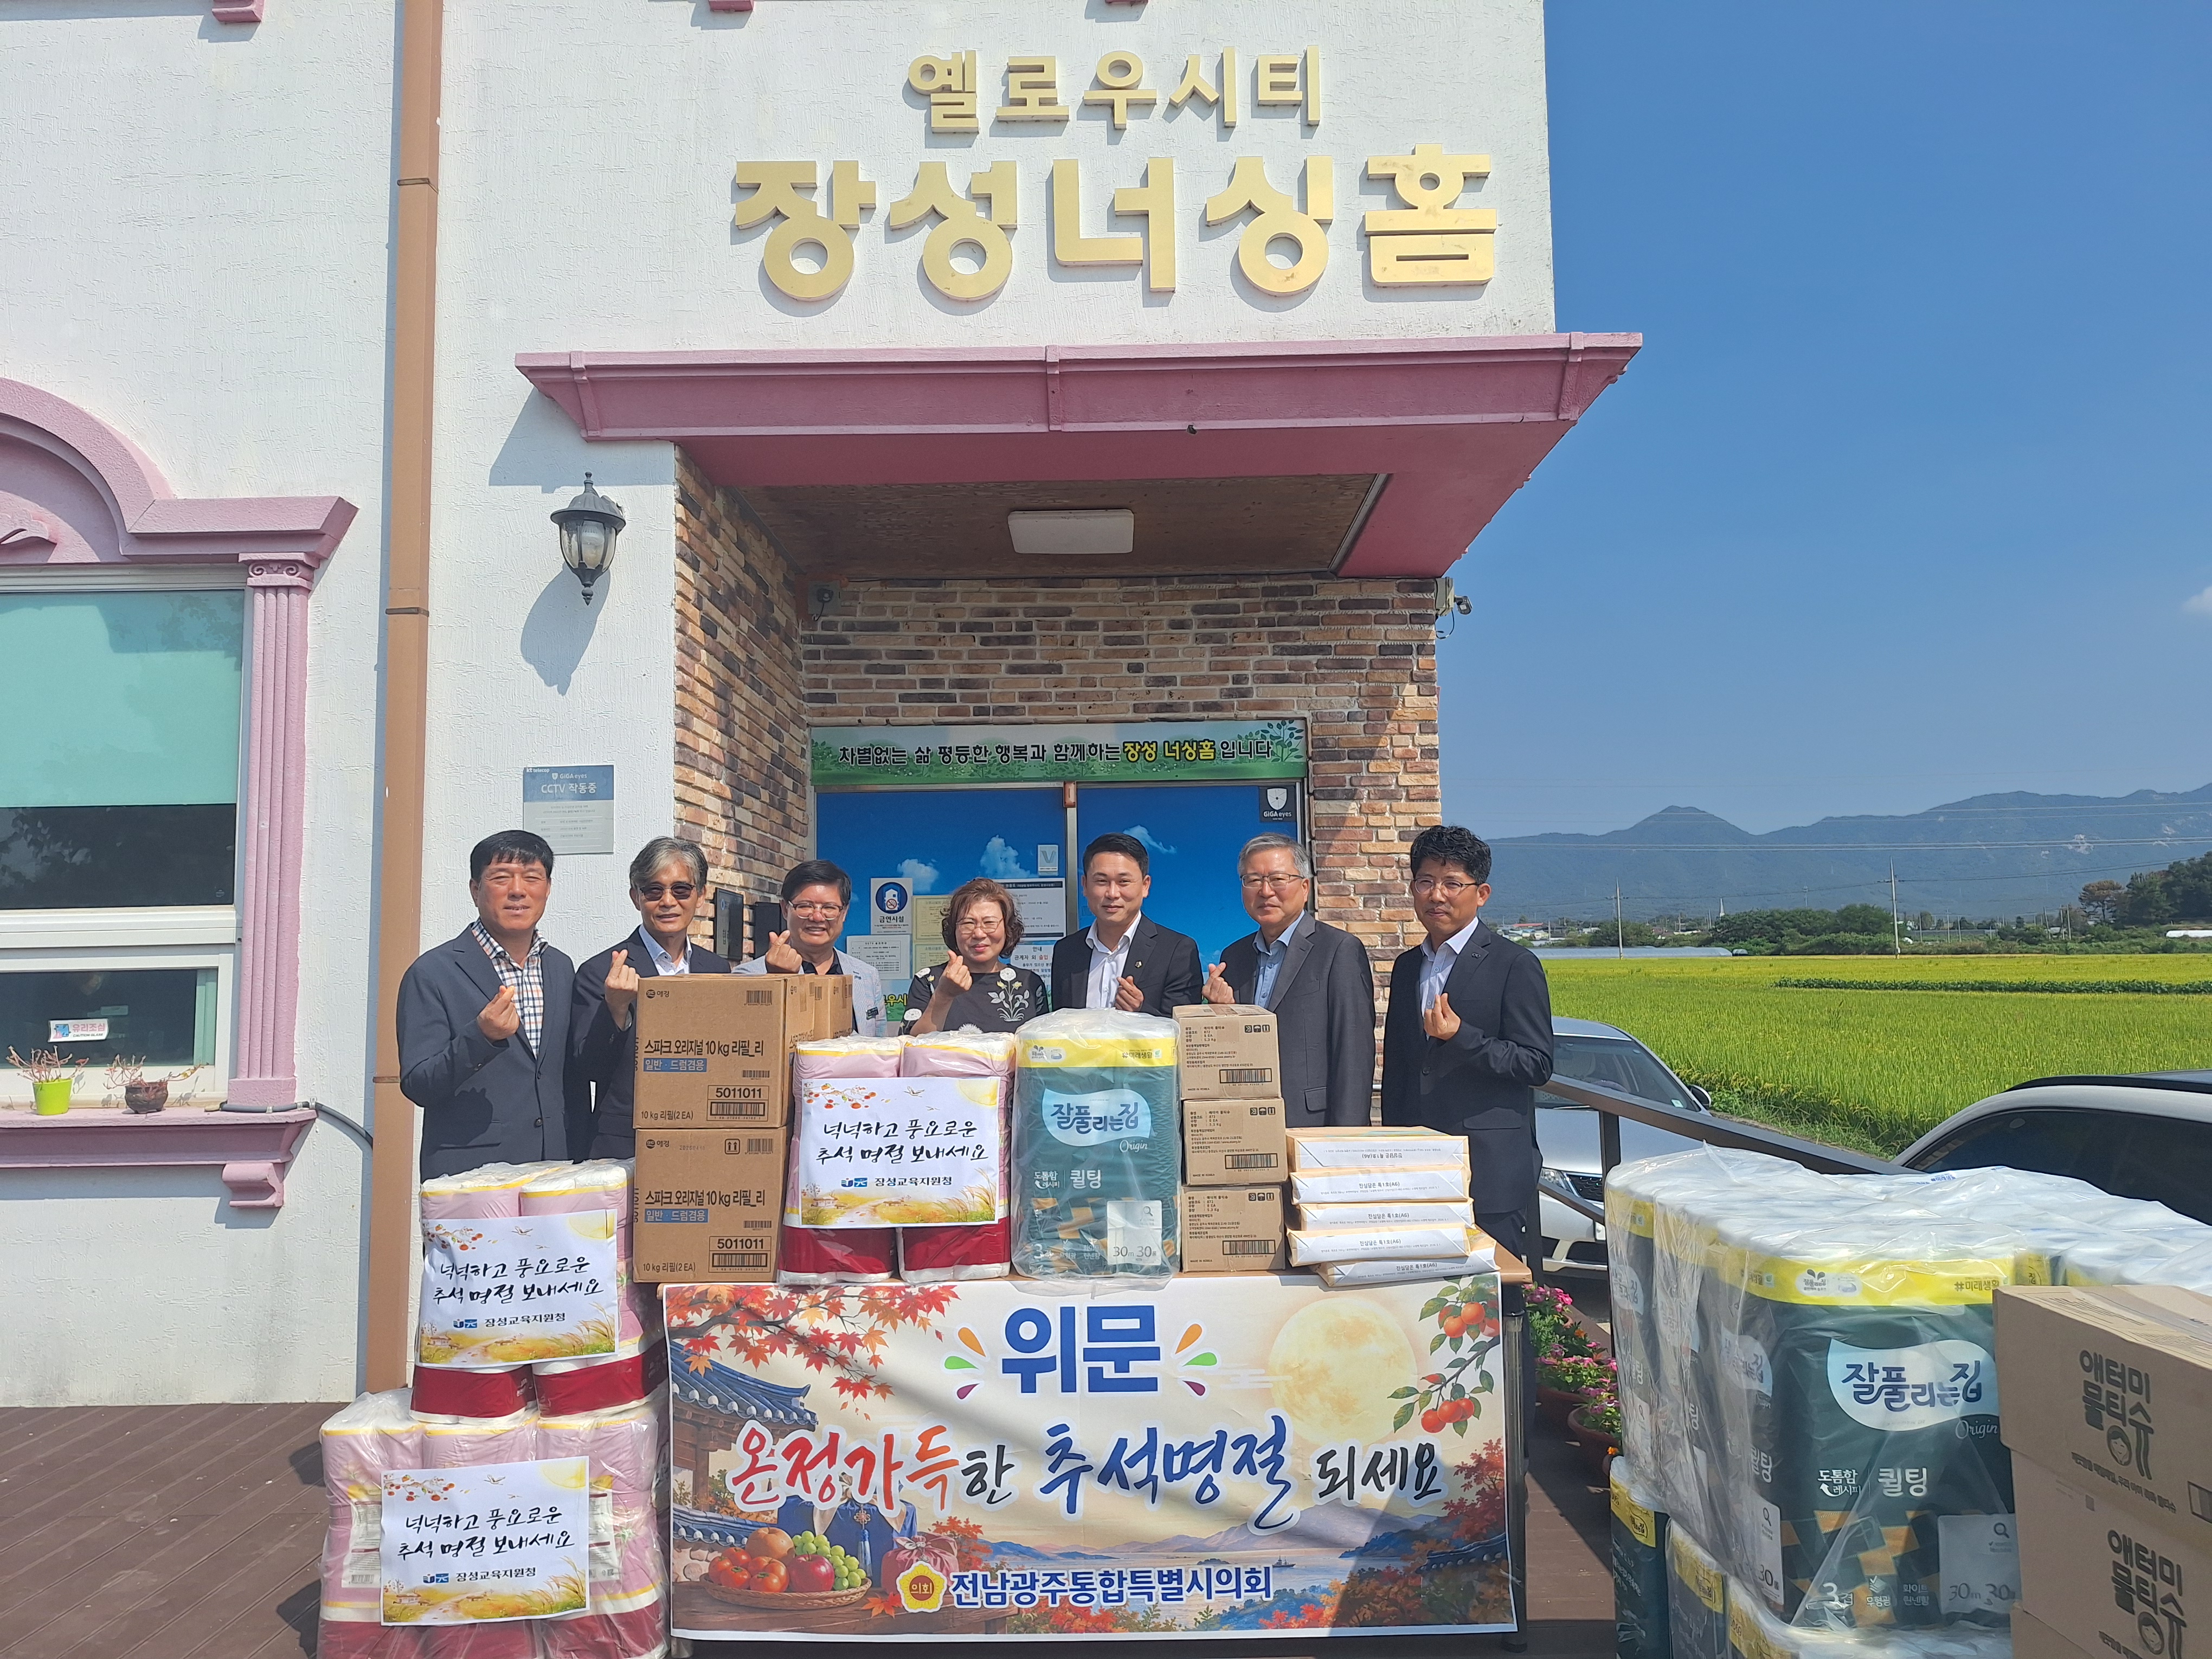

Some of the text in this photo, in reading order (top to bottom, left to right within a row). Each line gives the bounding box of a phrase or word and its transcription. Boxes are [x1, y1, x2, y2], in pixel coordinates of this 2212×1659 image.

[908, 45, 1321, 133] 옐로우시티
[735, 142, 1497, 301] 장성너싱홈
[839, 745, 908, 766] 차별없는
[915, 745, 931, 764] 삶
[938, 744, 989, 764] 평등한
[995, 743, 1047, 764] 행복과
[1123, 741, 1158, 762] 장성
[1162, 739, 1216, 761] 너싱홈
[1219, 739, 1274, 759] 입니다
[541, 782, 597, 794] CCTV 작동중
[657, 989, 670, 998] 애경
[72, 1023, 105, 1033] 유리조심
[644, 1039, 673, 1054] 스파크
[674, 1039, 703, 1056] 오리지널
[706, 1040, 716, 1054] 10
[717, 1040, 730, 1056] kg
[645, 1059, 705, 1071] 일반 드럼겸용
[716, 1088, 761, 1098] 5011011
[650, 1111, 658, 1121] kg
[660, 1110, 680, 1121] 리필(2
[681, 1109, 693, 1120] EA)
[1051, 1102, 1139, 1134] 잘풀리는집
[824, 1119, 978, 1140] 넉넉하고 풍요로운
[815, 1144, 989, 1165] 추석 명절 보내세요
[1119, 1139, 1148, 1153] Origin
[874, 1176, 953, 1186] 장성교육지원청
[1033, 1170, 1058, 1181] 도톰함
[1042, 1180, 1060, 1188] 레시피
[1070, 1169, 1102, 1189] 퀼팅
[645, 1189, 673, 1205] 스파크
[674, 1189, 704, 1206] 오리지널
[706, 1192, 717, 1205] 10
[719, 1192, 731, 1206] kg
[646, 1210, 705, 1221] 일반 드럼겸용
[717, 1238, 763, 1249] 5011011
[440, 1256, 591, 1281] 넉넉하고 풍요로운
[652, 1263, 660, 1272] kg
[662, 1262, 682, 1272] 리필(2
[684, 1262, 696, 1272] EA)
[433, 1278, 605, 1305] 추석 명절 보내세요
[484, 1312, 566, 1327] 장성교육지원청
[1001, 1305, 1161, 1394] 위문
[2079, 1349, 2151, 1404] 애터미
[1842, 1360, 1982, 1412] 잘풀리는집
[1955, 1419, 1998, 1439] Origin
[2082, 1379, 2155, 1480] 물티슈
[731, 1415, 1442, 1528] 온정가득한 추석명절 되세요
[1817, 1469, 1859, 1485] 도톰함
[1832, 1484, 1861, 1496] 레시피
[1877, 1467, 1928, 1497] 퀼팅
[406, 1506, 563, 1534] 넉넉하고 풍요로운
[397, 1531, 576, 1561] 추석 명절 보내세요
[2107, 1529, 2183, 1597] 애터미
[455, 1567, 537, 1582] 장성교육지원청
[911, 1583, 933, 1595] 의회
[952, 1566, 1272, 1605] 전남광주통합특별시의회
[1902, 1584, 1928, 1593] 화이트
[2111, 1560, 2187, 1659] 물티슈
